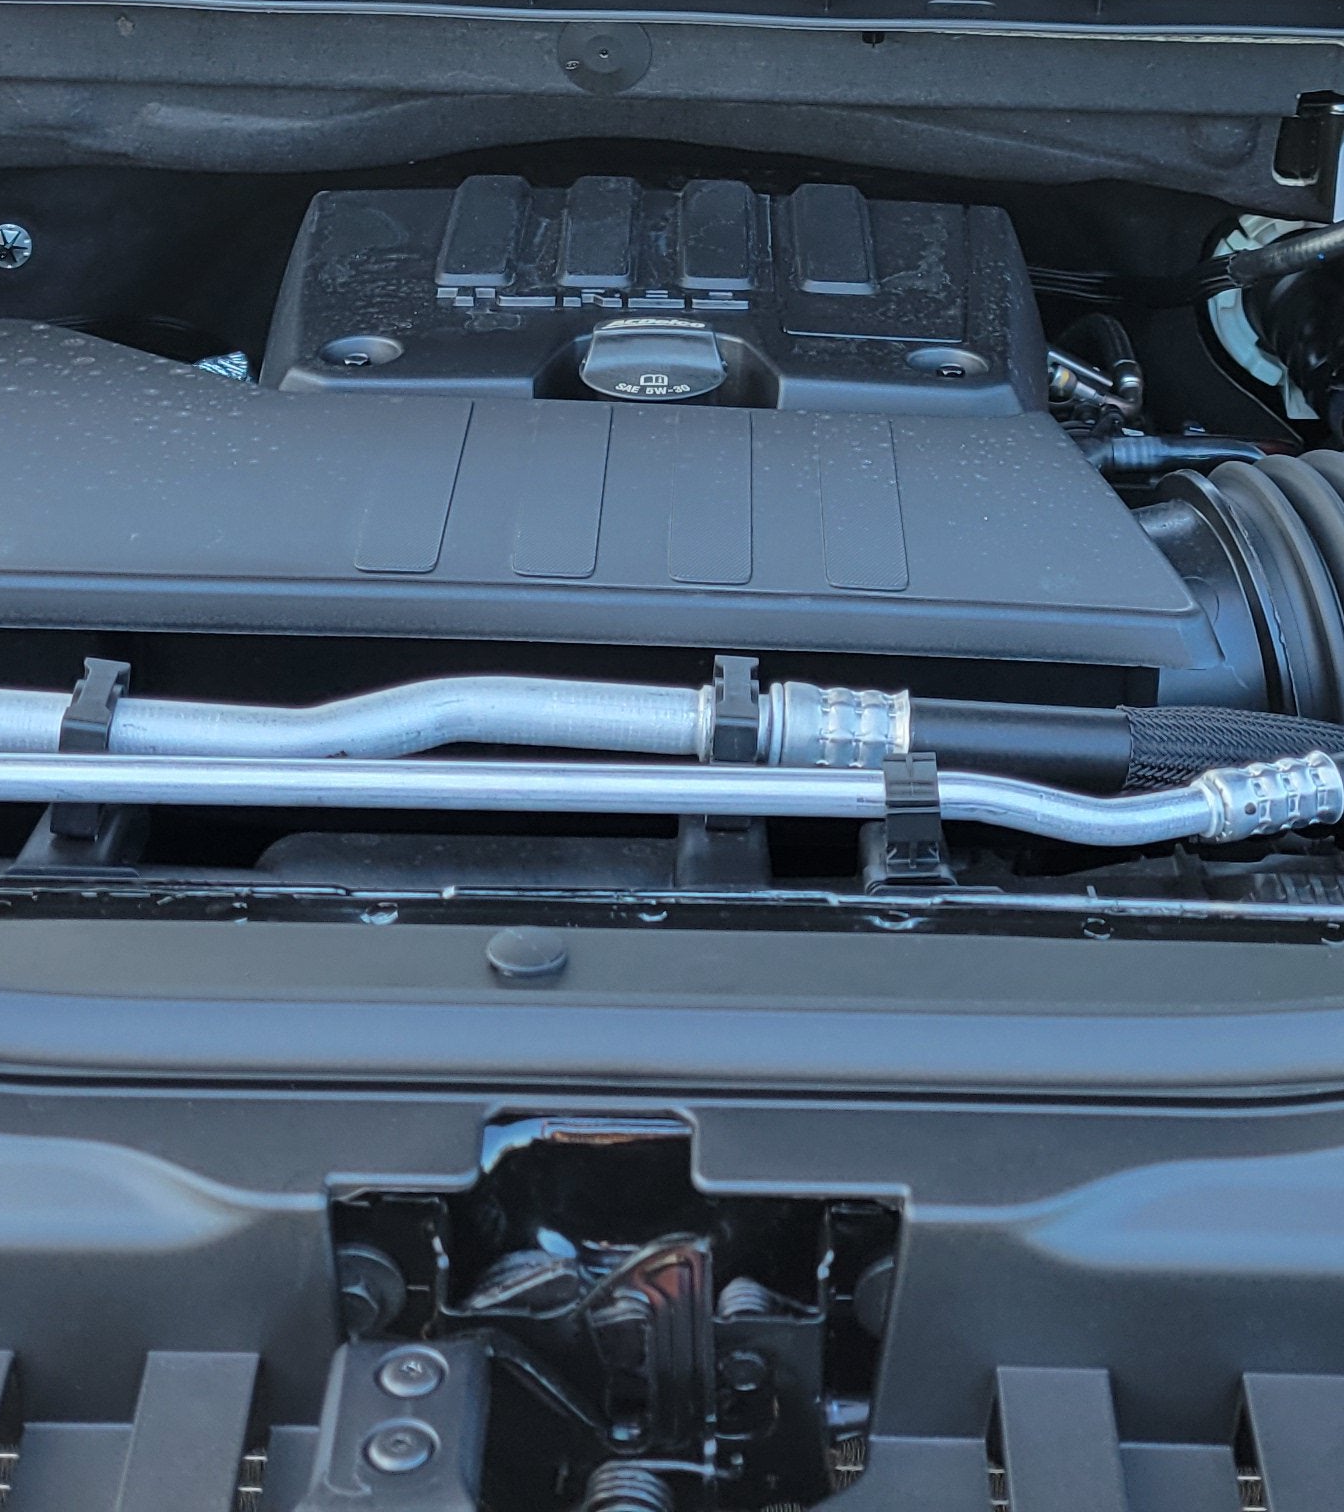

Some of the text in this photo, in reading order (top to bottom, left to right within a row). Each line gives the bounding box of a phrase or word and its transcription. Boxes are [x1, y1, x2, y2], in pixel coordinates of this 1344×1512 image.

[601, 319, 706, 329] ACDelco
[615, 383, 690, 395] SAE 5W-30
